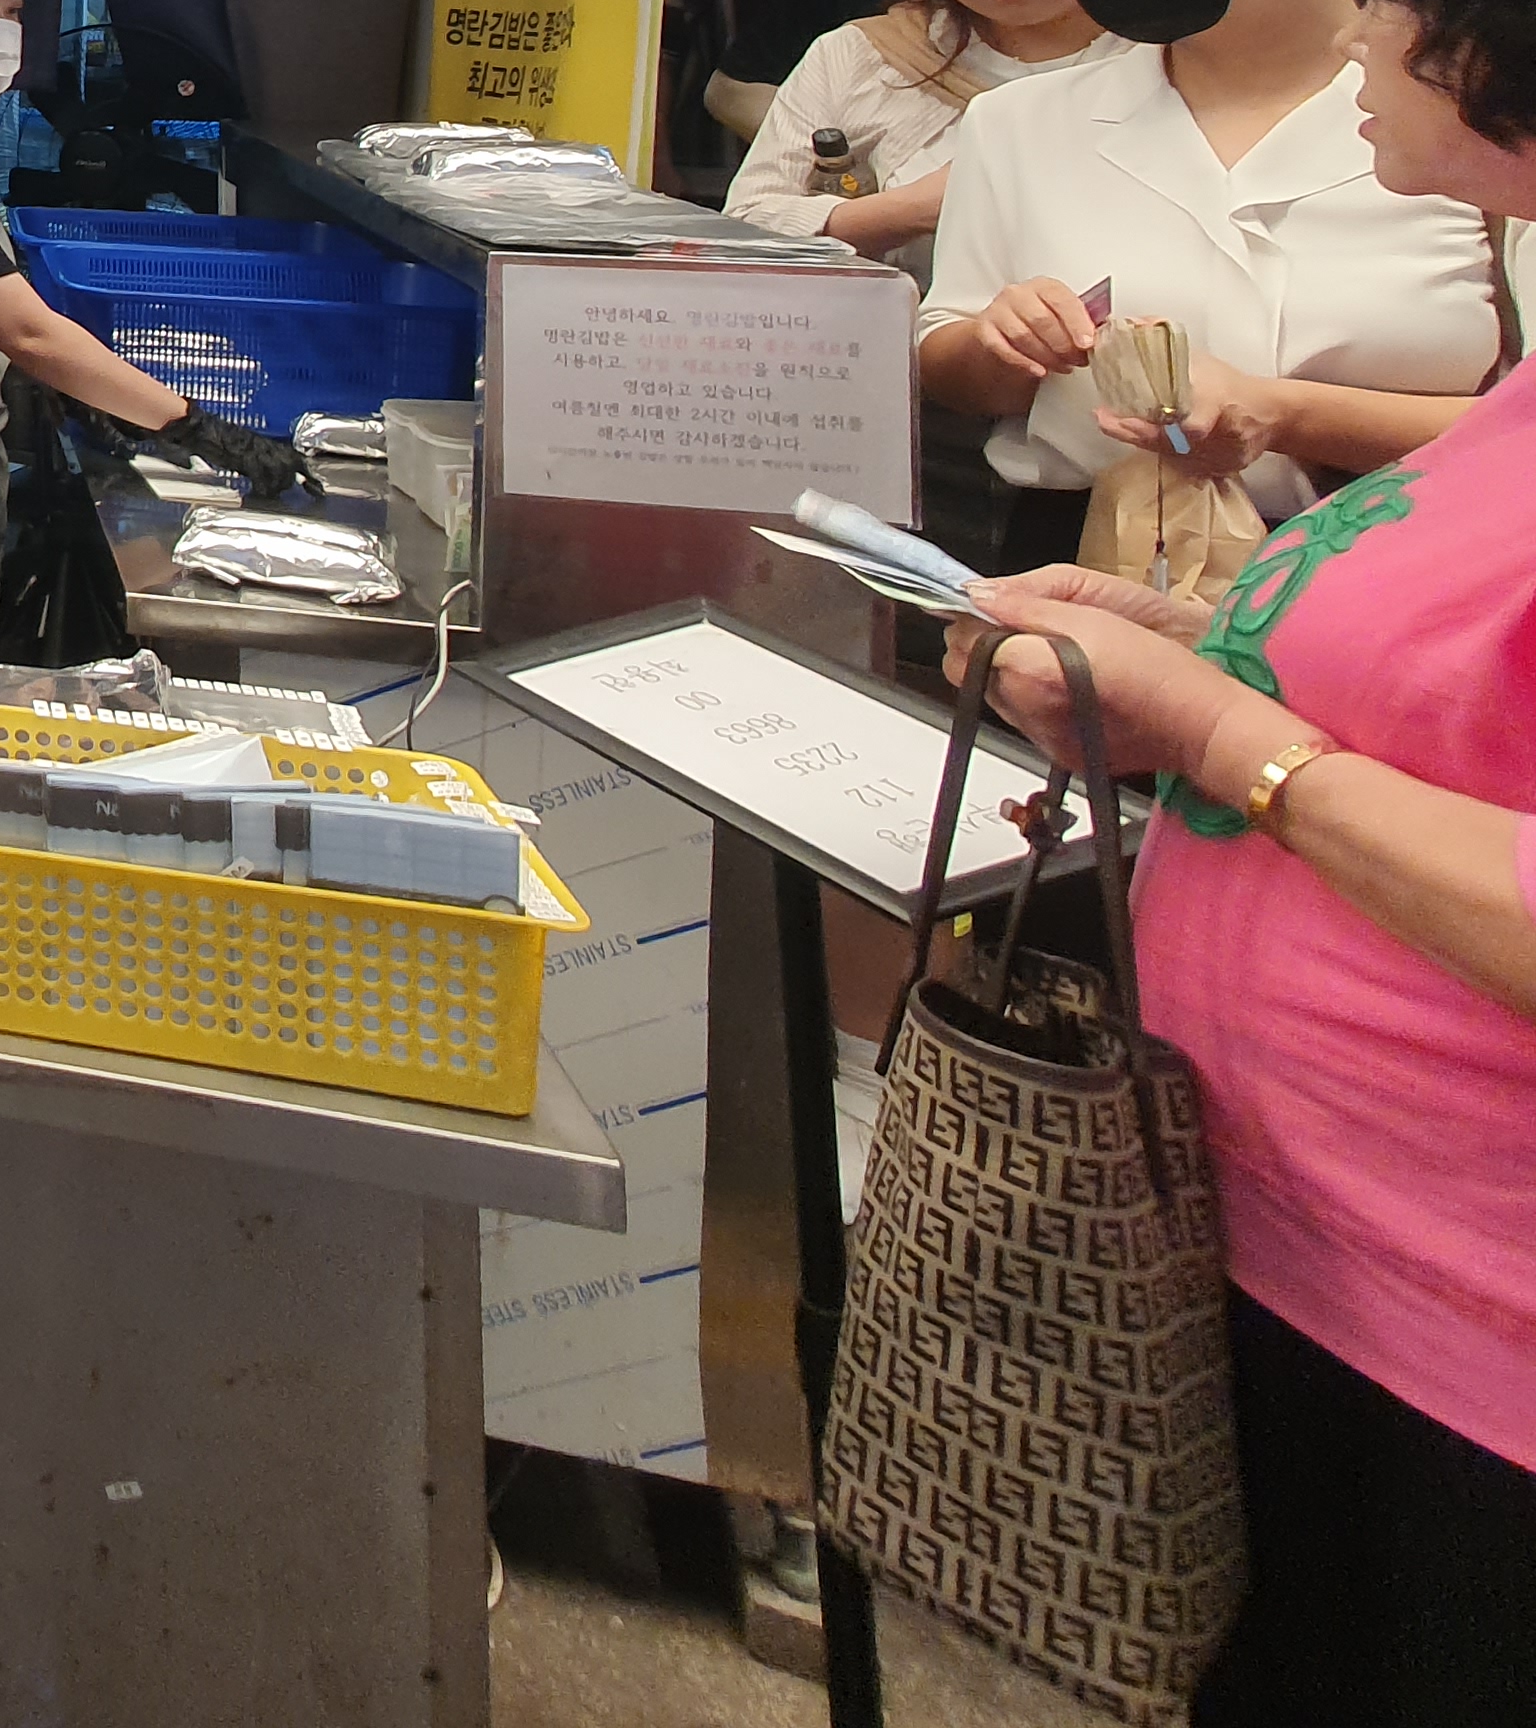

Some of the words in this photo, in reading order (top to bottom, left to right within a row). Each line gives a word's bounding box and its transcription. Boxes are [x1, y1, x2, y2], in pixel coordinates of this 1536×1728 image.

[446, 7, 540, 52] 명란김밥은
[543, 328, 628, 347] 명란김밥은
[623, 379, 692, 398] 영업하고
[690, 408, 735, 426] 2시간
[597, 426, 666, 445] 해주시면
